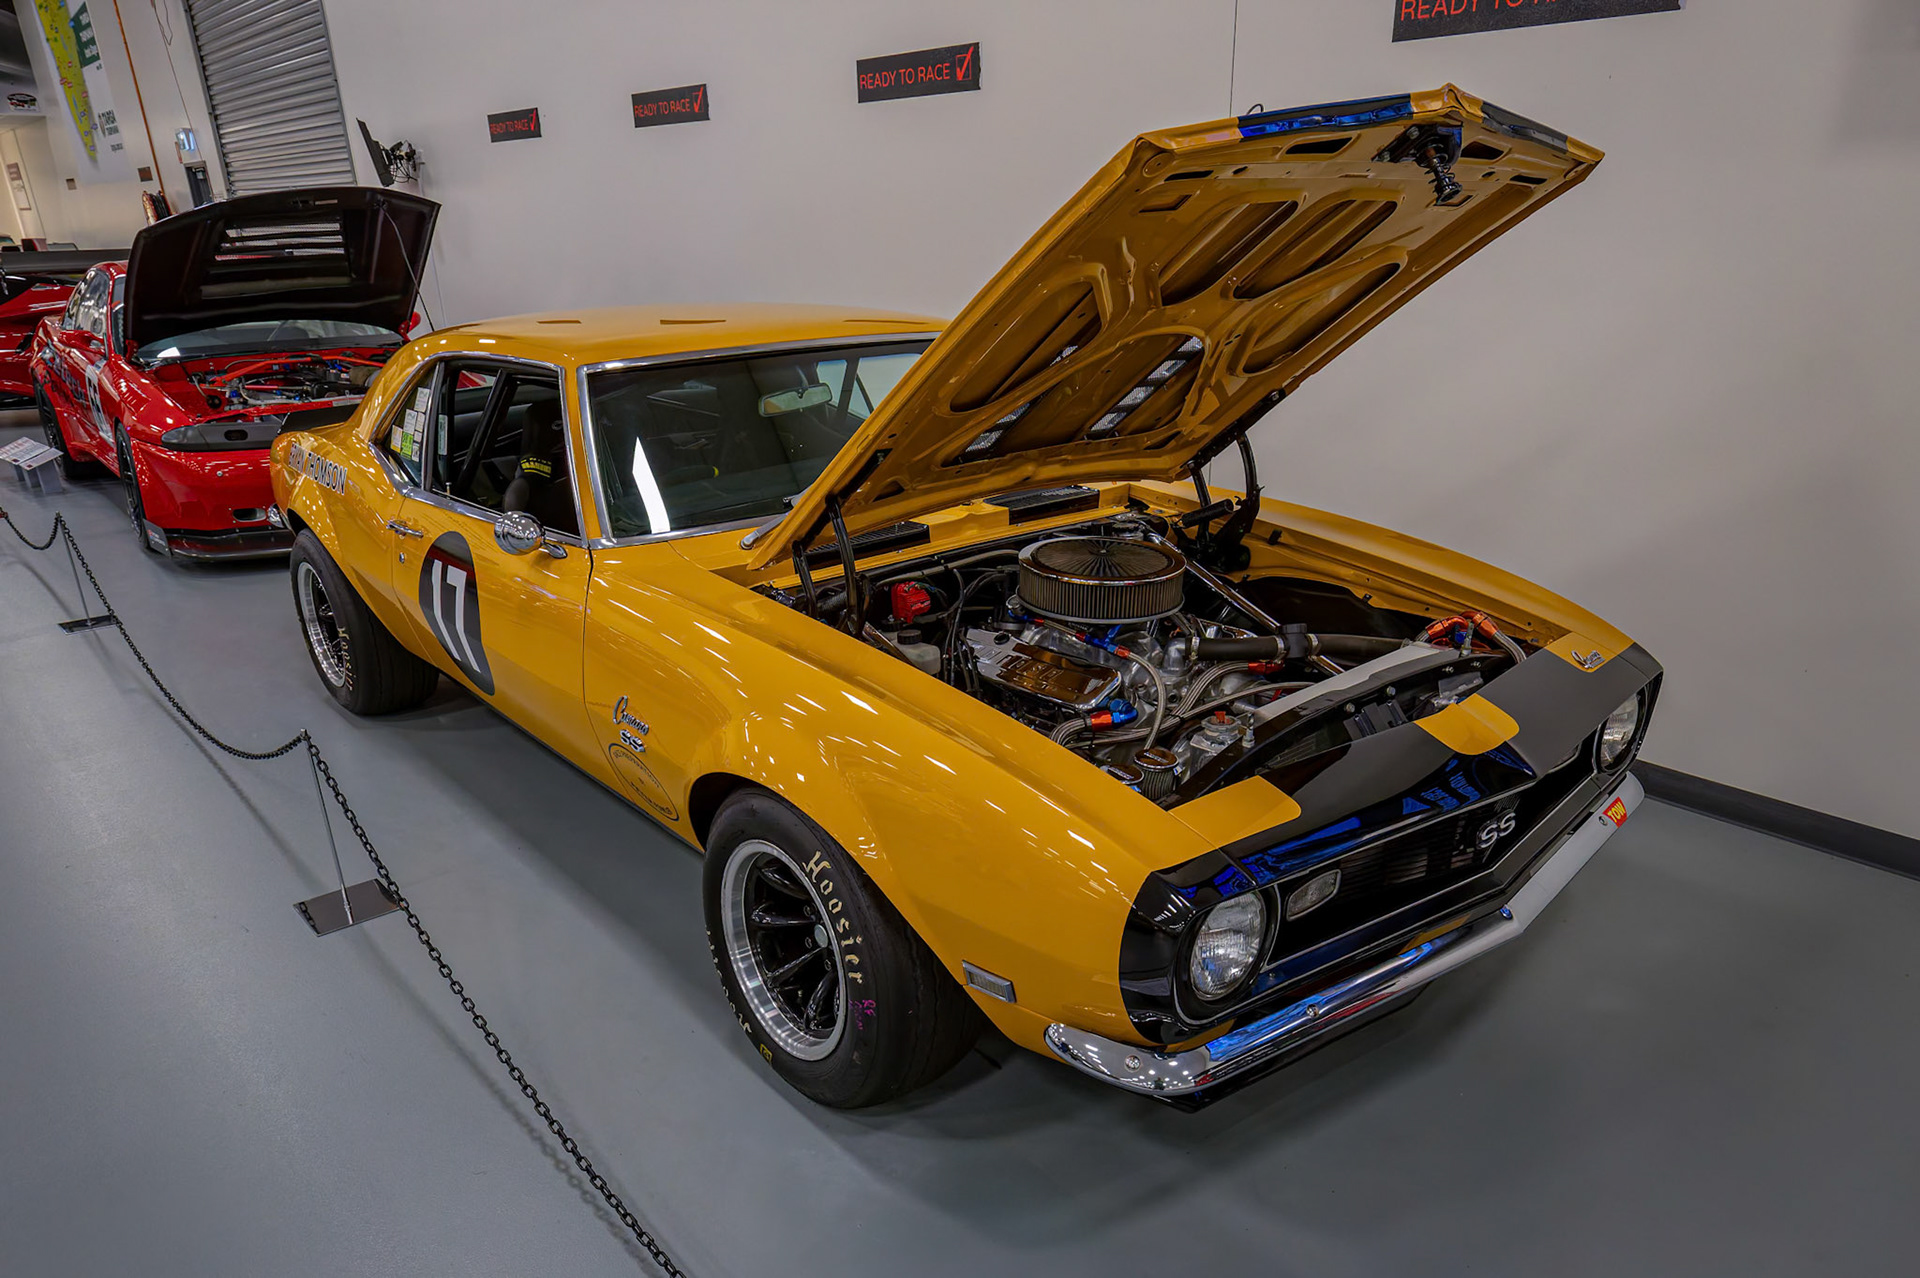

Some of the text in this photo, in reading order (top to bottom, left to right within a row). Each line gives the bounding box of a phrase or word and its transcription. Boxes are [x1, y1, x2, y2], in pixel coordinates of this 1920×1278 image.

[859, 63, 951, 90] READY TO RACE
[634, 98, 691, 118] READY TO RACE
[304, 450, 348, 496] THOMSON
[431, 559, 481, 673] 17
[619, 729, 646, 752] SS
[1607, 800, 1627, 822] TOW
[1478, 810, 1517, 849] SS
[802, 851, 864, 984] Hoosier
